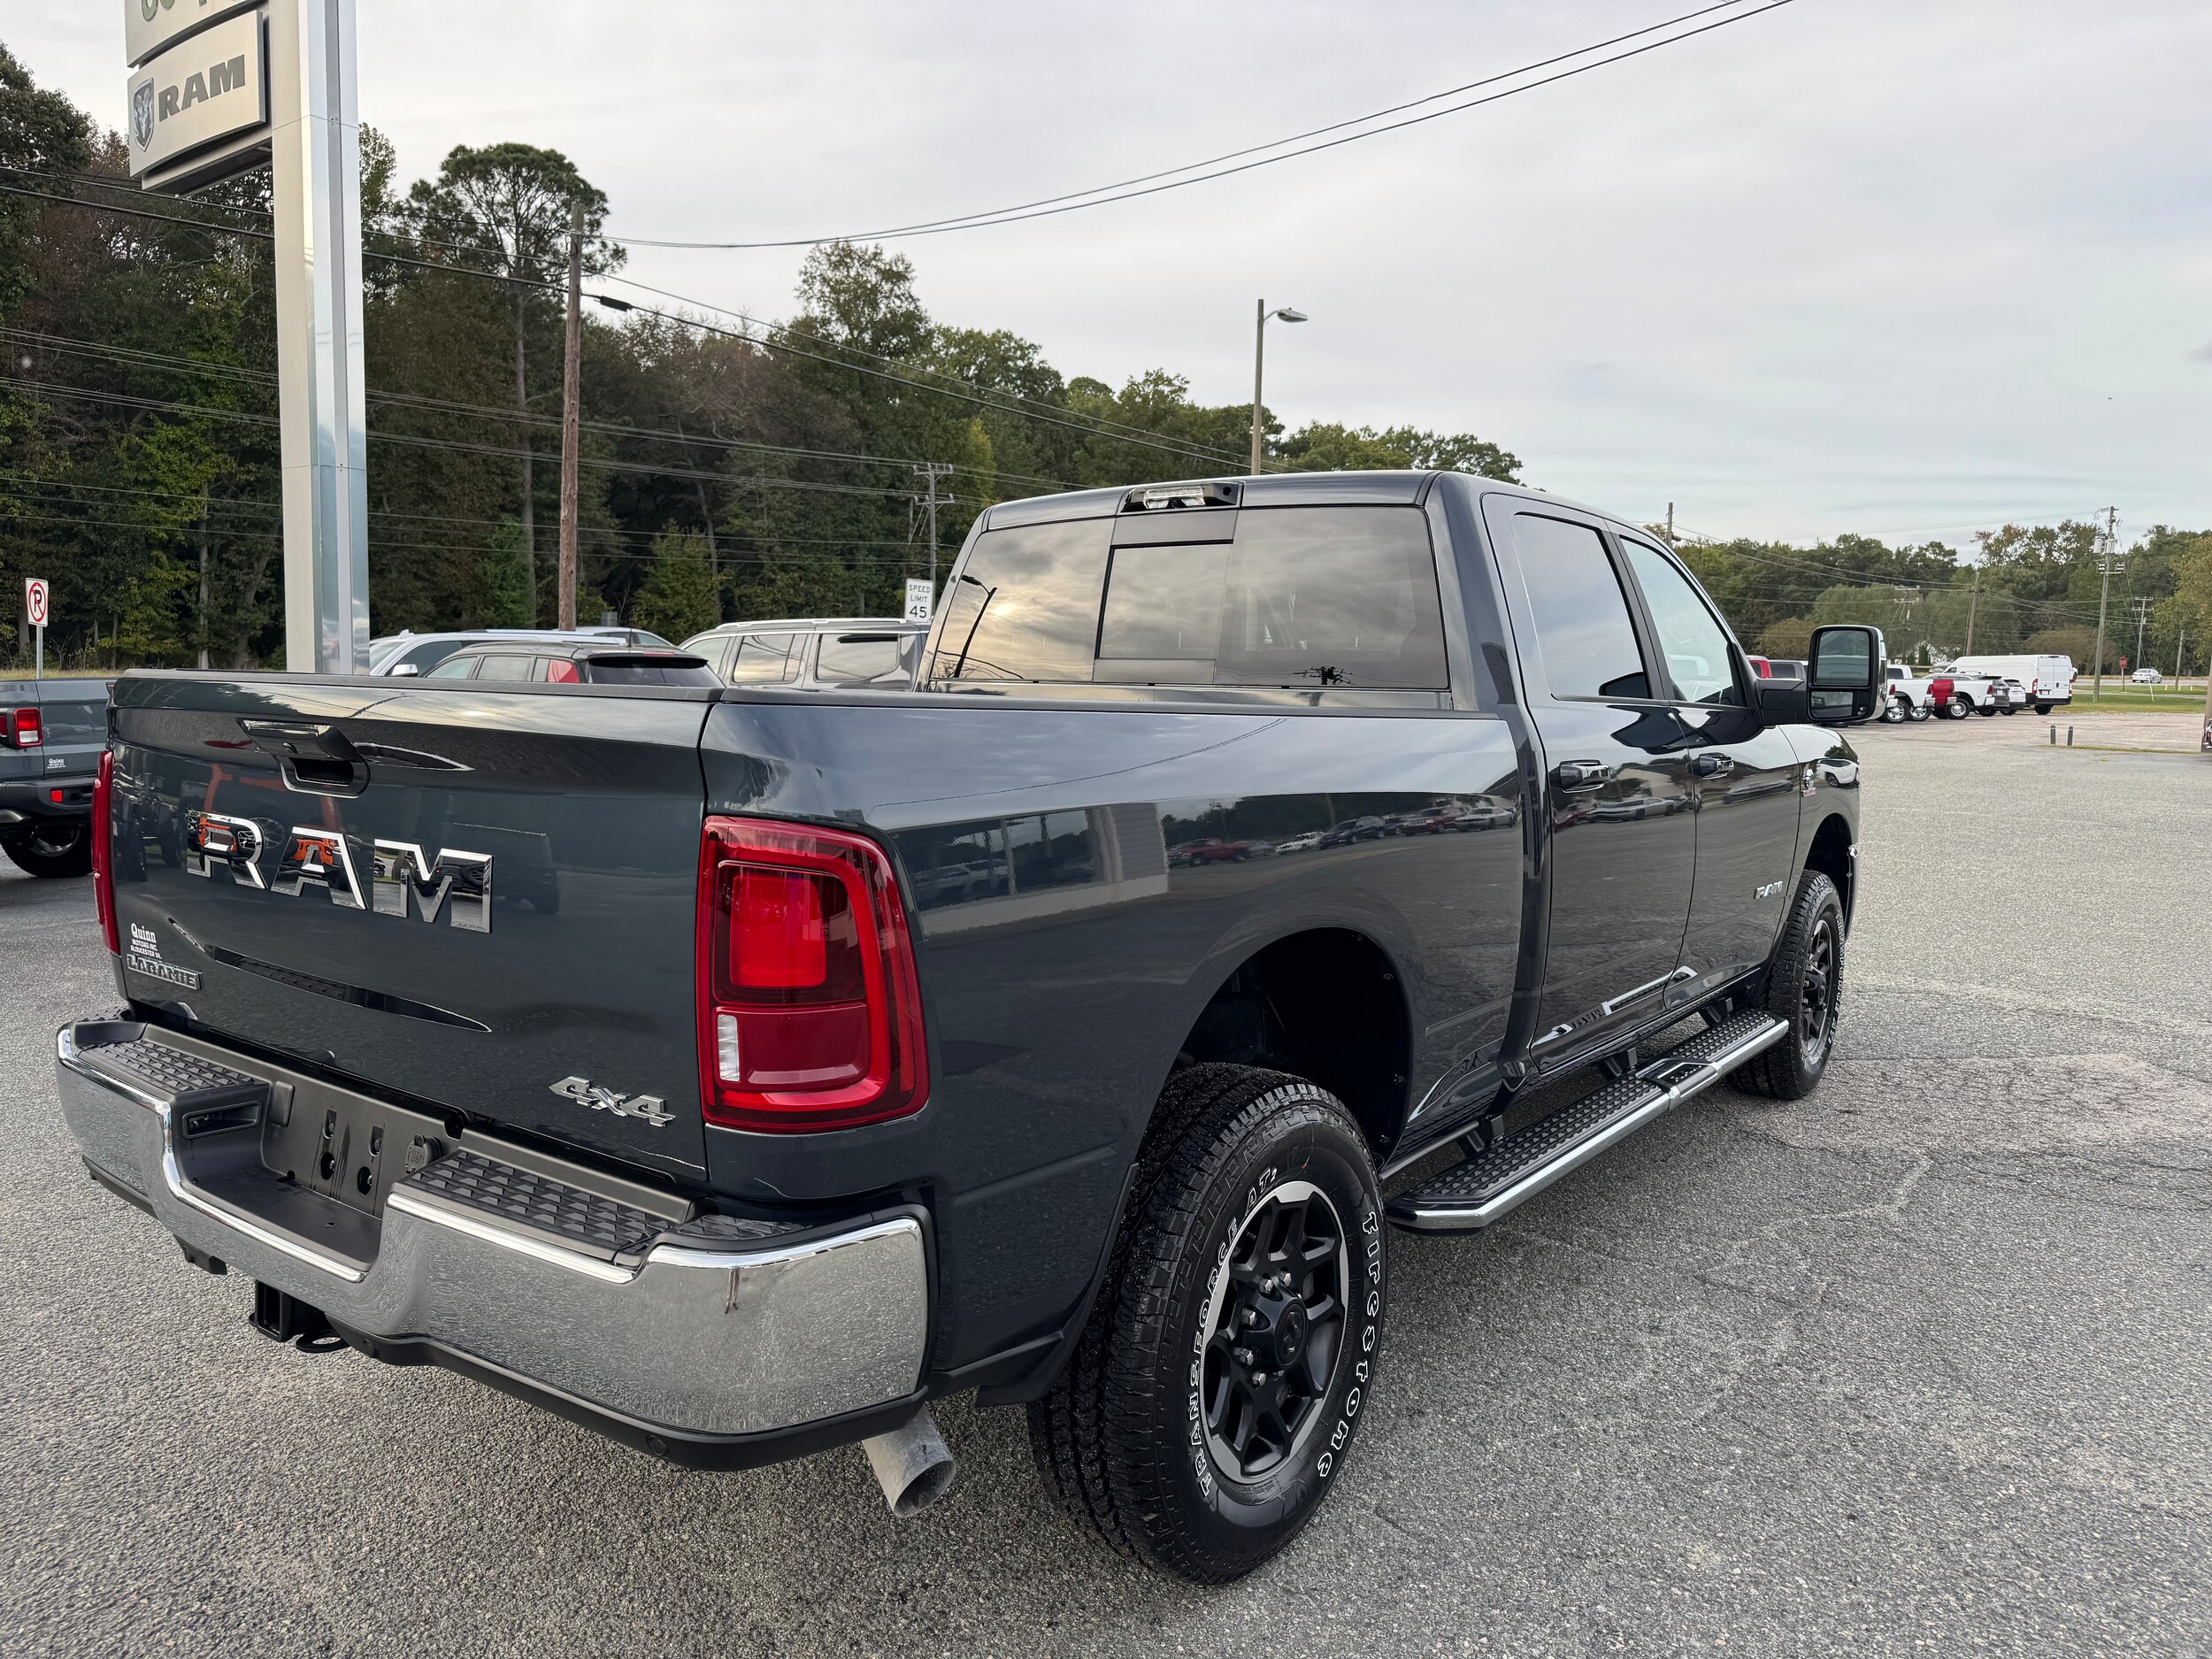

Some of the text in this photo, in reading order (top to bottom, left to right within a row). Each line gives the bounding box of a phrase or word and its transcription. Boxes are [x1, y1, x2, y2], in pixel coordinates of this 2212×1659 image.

[157, 54, 246, 122] RAM
[908, 584, 931, 594] SPEED
[910, 594, 927, 603] LIMIT
[909, 605, 927, 618] 45
[187, 809, 494, 933] RAM
[131, 922, 157, 943] Quinn
[132, 938, 149, 949] MOTORS
[130, 945, 155, 956] GLOUCESTER
[1317, 1211, 1380, 1478] Firestone
